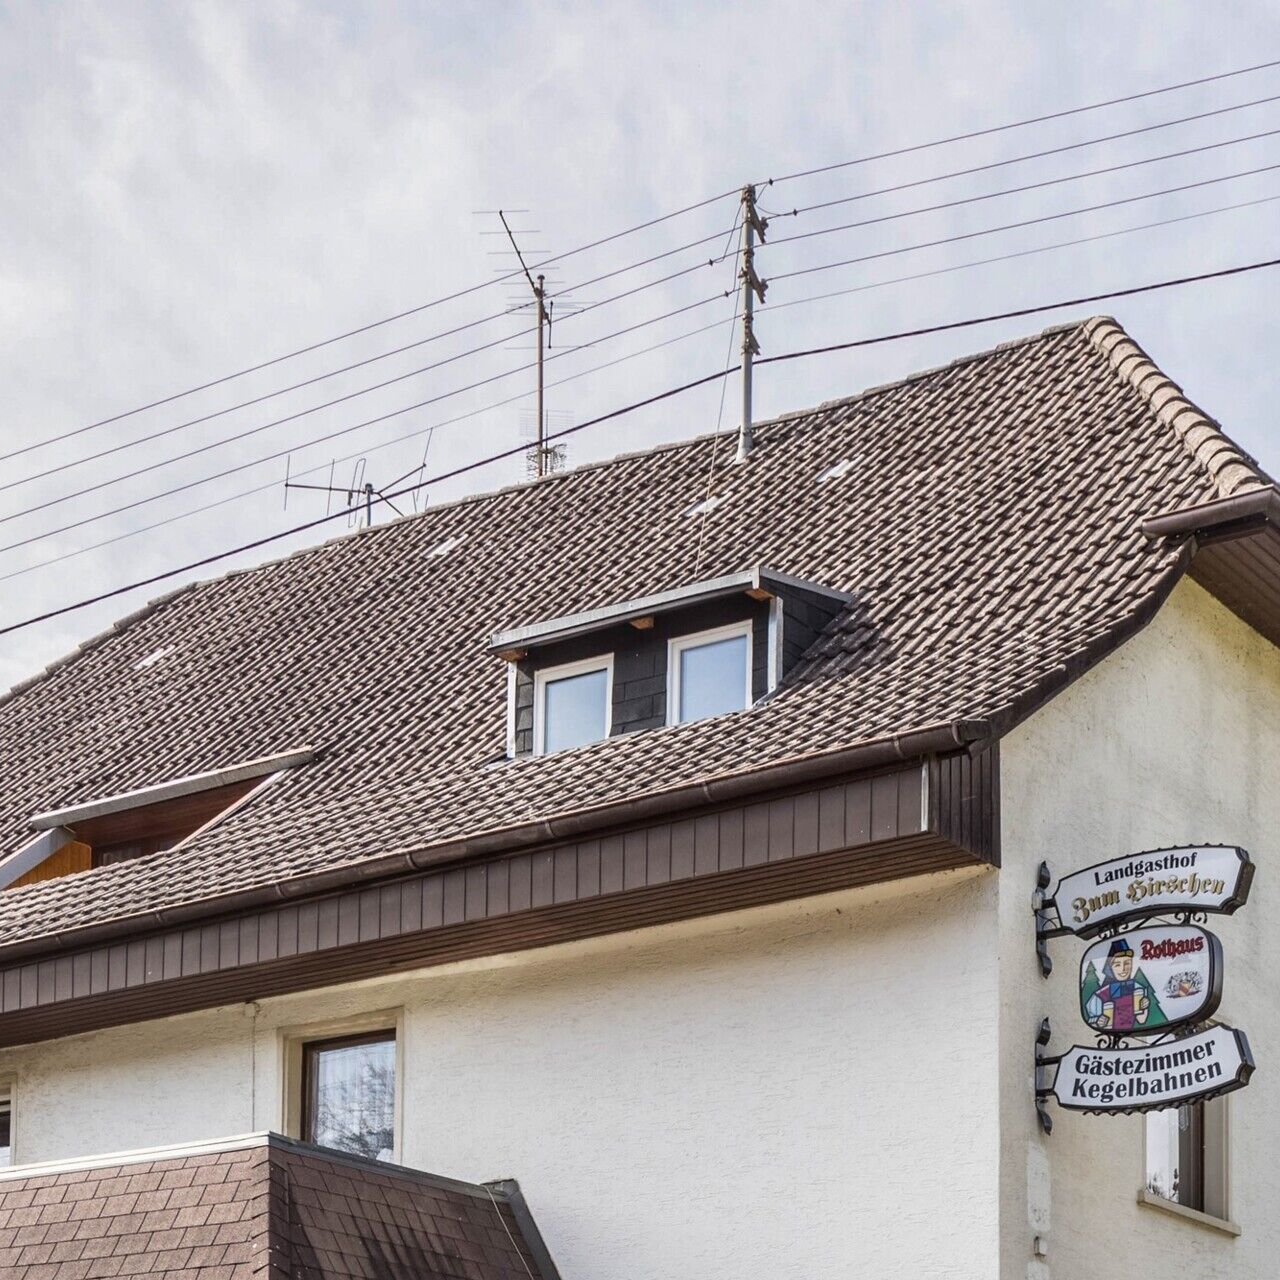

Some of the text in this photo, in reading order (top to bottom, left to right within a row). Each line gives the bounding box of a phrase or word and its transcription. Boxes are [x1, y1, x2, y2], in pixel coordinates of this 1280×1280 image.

[1094, 852, 1198, 886] Landgasthof
[1072, 871, 1226, 924] Zum Hirschen
[1140, 936, 1204, 961] Rothaus
[1075, 1039, 1216, 1076] Gästezimmer
[1071, 1061, 1222, 1102] Kegelbahnen
